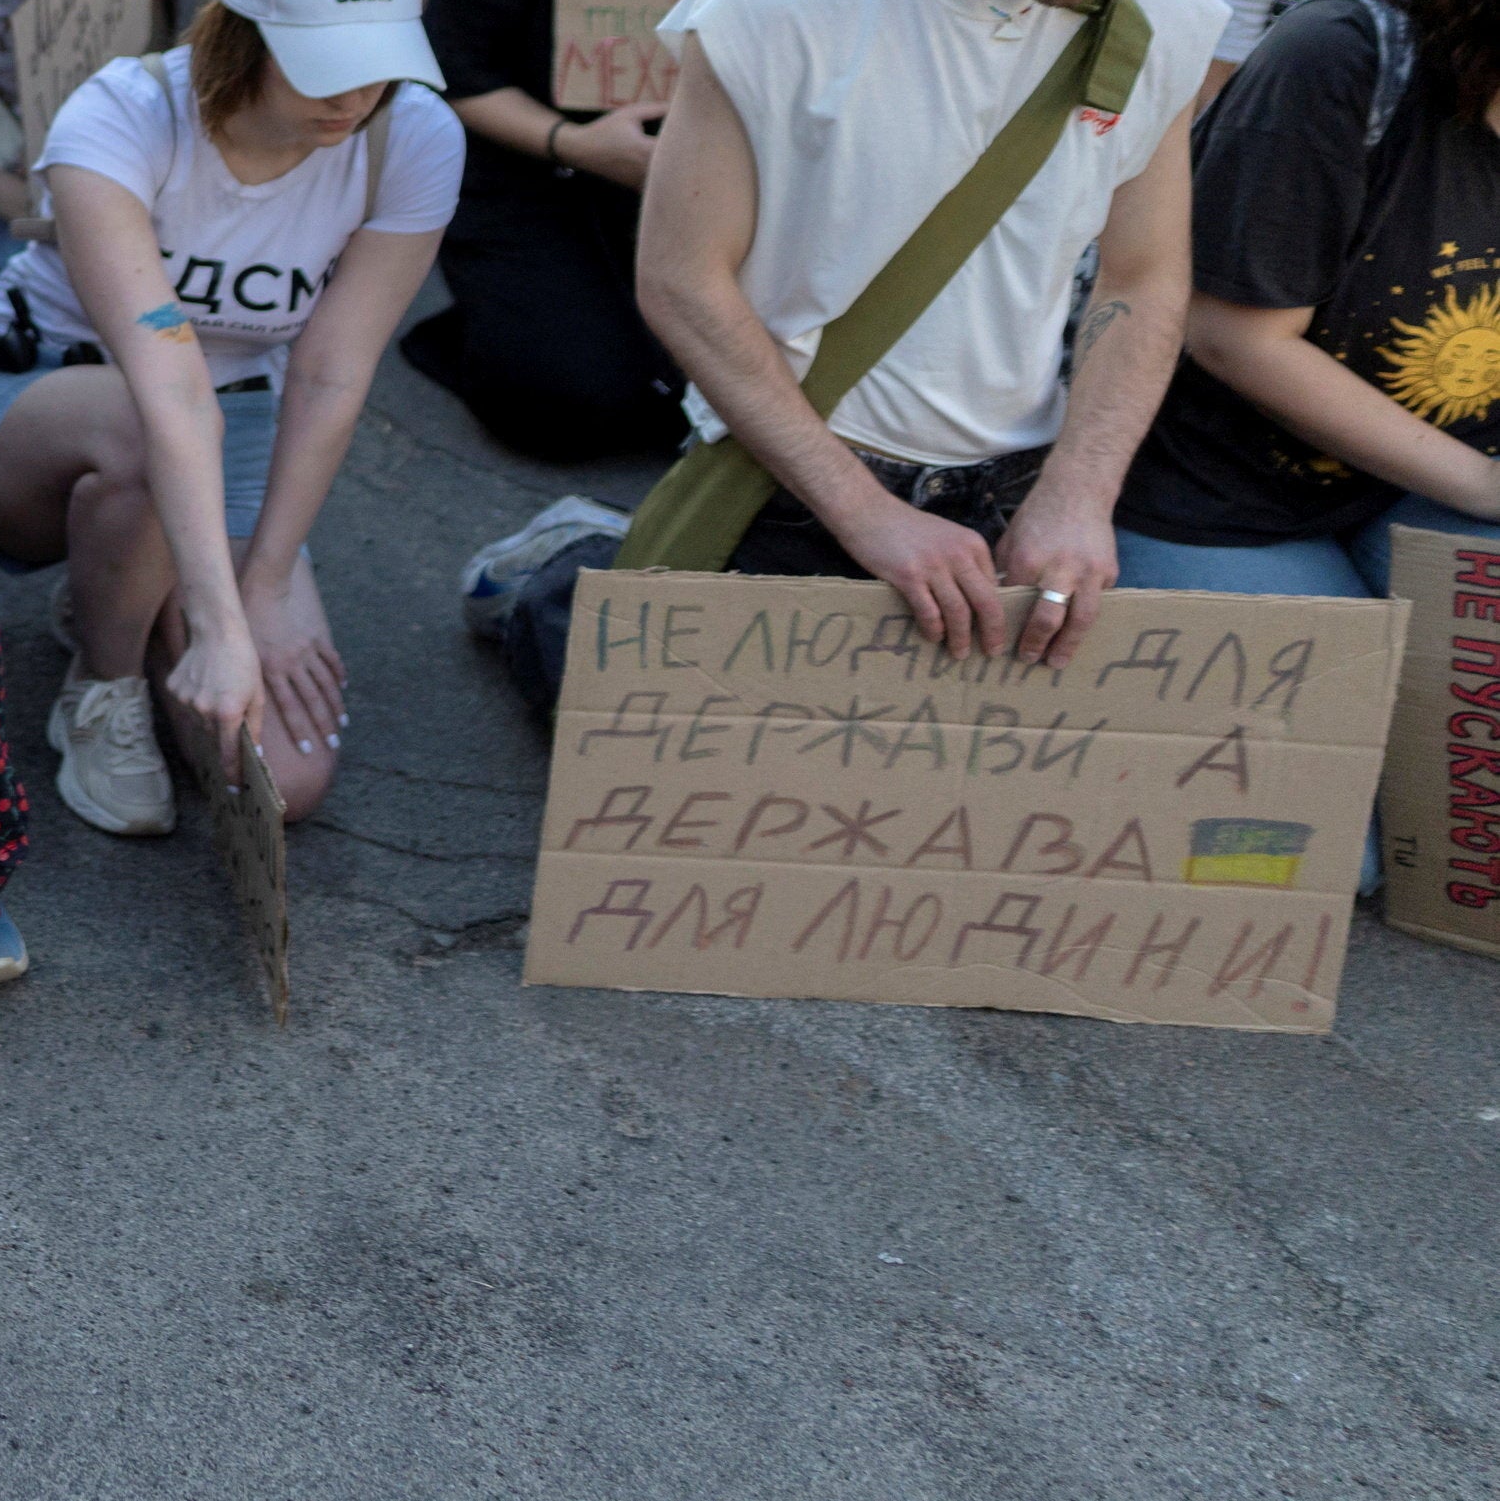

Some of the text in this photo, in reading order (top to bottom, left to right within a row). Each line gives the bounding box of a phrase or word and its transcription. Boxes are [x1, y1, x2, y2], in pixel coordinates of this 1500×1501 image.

[160, 247, 342, 314] ДСМ
[1453, 549, 1500, 624] НЕ
[596, 598, 703, 673] НЕ
[1095, 627, 1316, 714] ДЛЯ
[1175, 722, 1250, 796] А
[563, 784, 1156, 884] ДЕРЖАВА
[566, 877, 1334, 1015] ДЛЯ ЛЮДИНИ!
